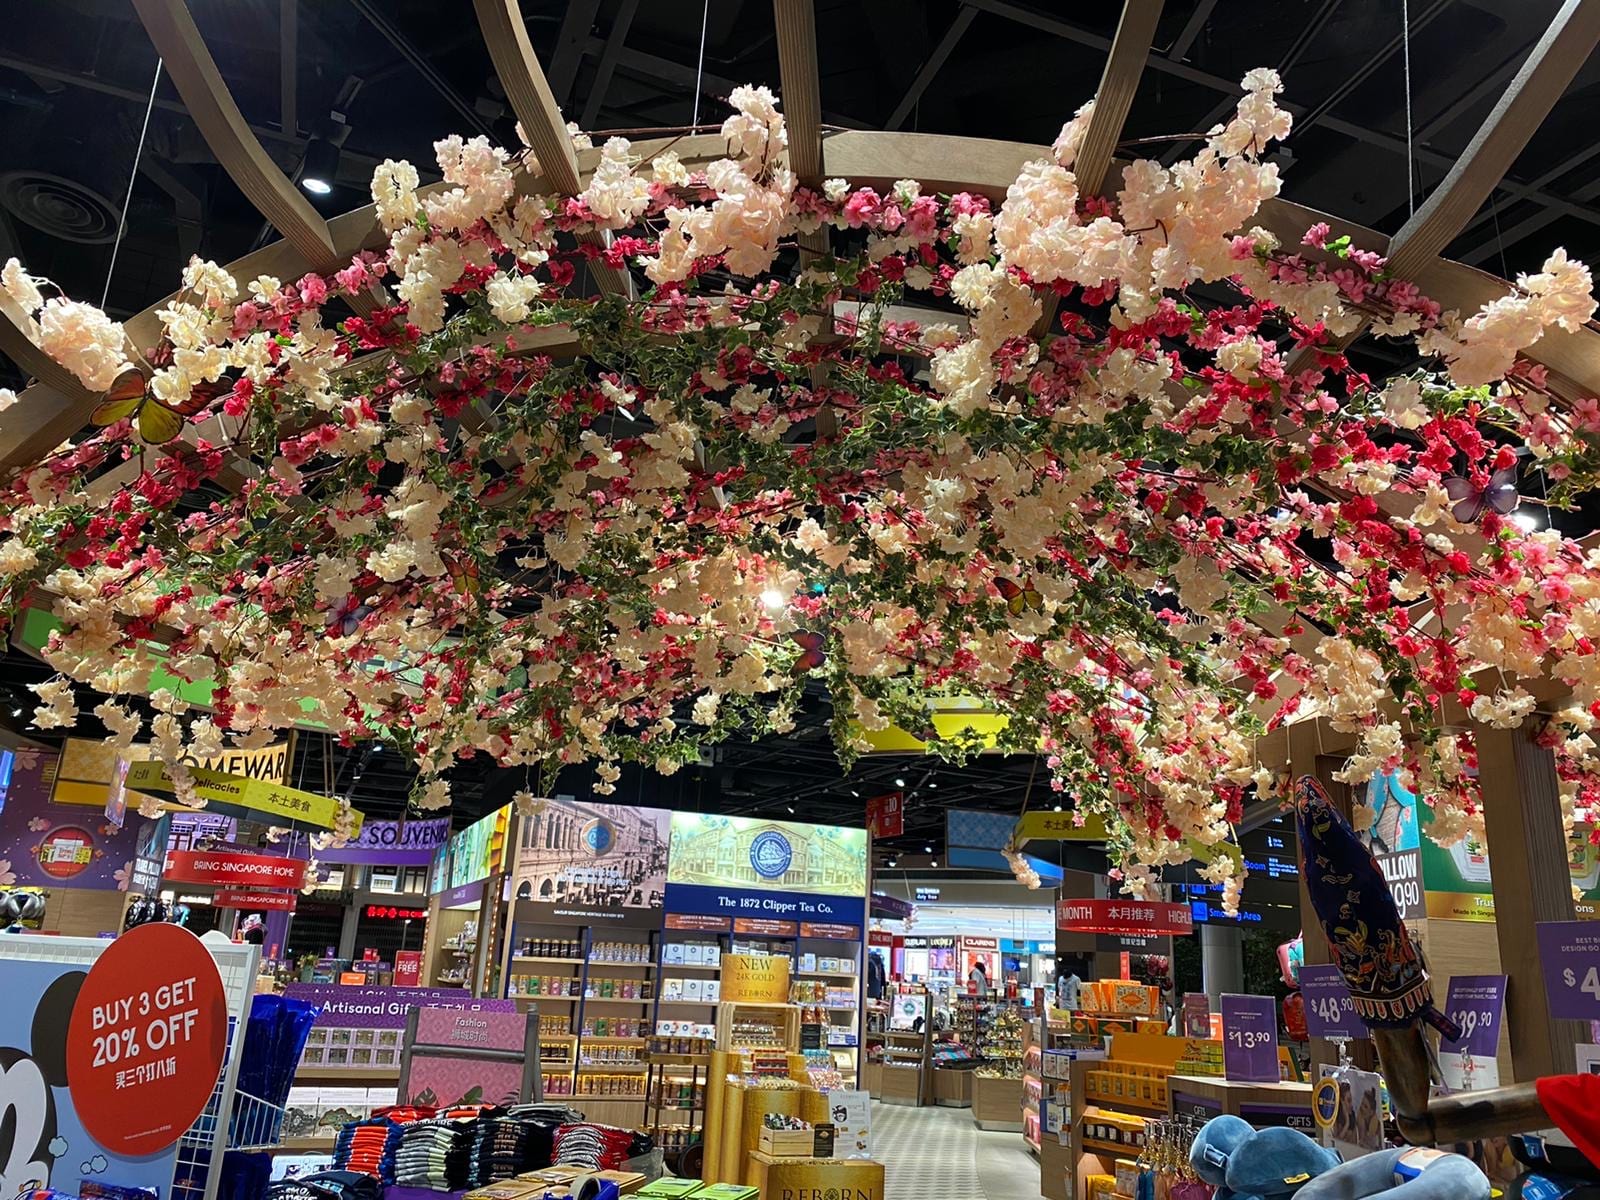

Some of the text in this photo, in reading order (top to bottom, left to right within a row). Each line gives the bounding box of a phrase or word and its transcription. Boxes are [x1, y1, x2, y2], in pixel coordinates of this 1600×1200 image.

[268, 791, 312, 814] 本土美食
[193, 859, 295, 878] BRING SINGAPORE HOME
[246, 895, 276, 904] SINGAPORE
[718, 896, 833, 914] The 1872 Clipper Tea Co.
[1474, 897, 1495, 908] Trus
[1062, 906, 1093, 920] MONTH
[1107, 906, 1156, 921] 本月推荐
[1575, 904, 1595, 914] ons
[1243, 911, 1261, 921] Area
[966, 939, 996, 947] CLARINS
[398, 964, 417, 973] FREE
[740, 958, 772, 970] NEW
[751, 973, 775, 982] GOLD
[93, 977, 197, 1030] BUY 3 GET
[322, 1001, 384, 1015] Artisanal
[388, 1003, 412, 1016] Gif
[1311, 997, 1353, 1023] $48.90
[455, 1017, 487, 1028] Fashion
[92, 1009, 199, 1067] 20% OFF
[1229, 1031, 1270, 1048] $13.90
[115, 1056, 177, 1090] 买三个打八折
[1194, 1105, 1206, 1117] GIFTS
[1287, 1116, 1312, 1127] GIFTS
